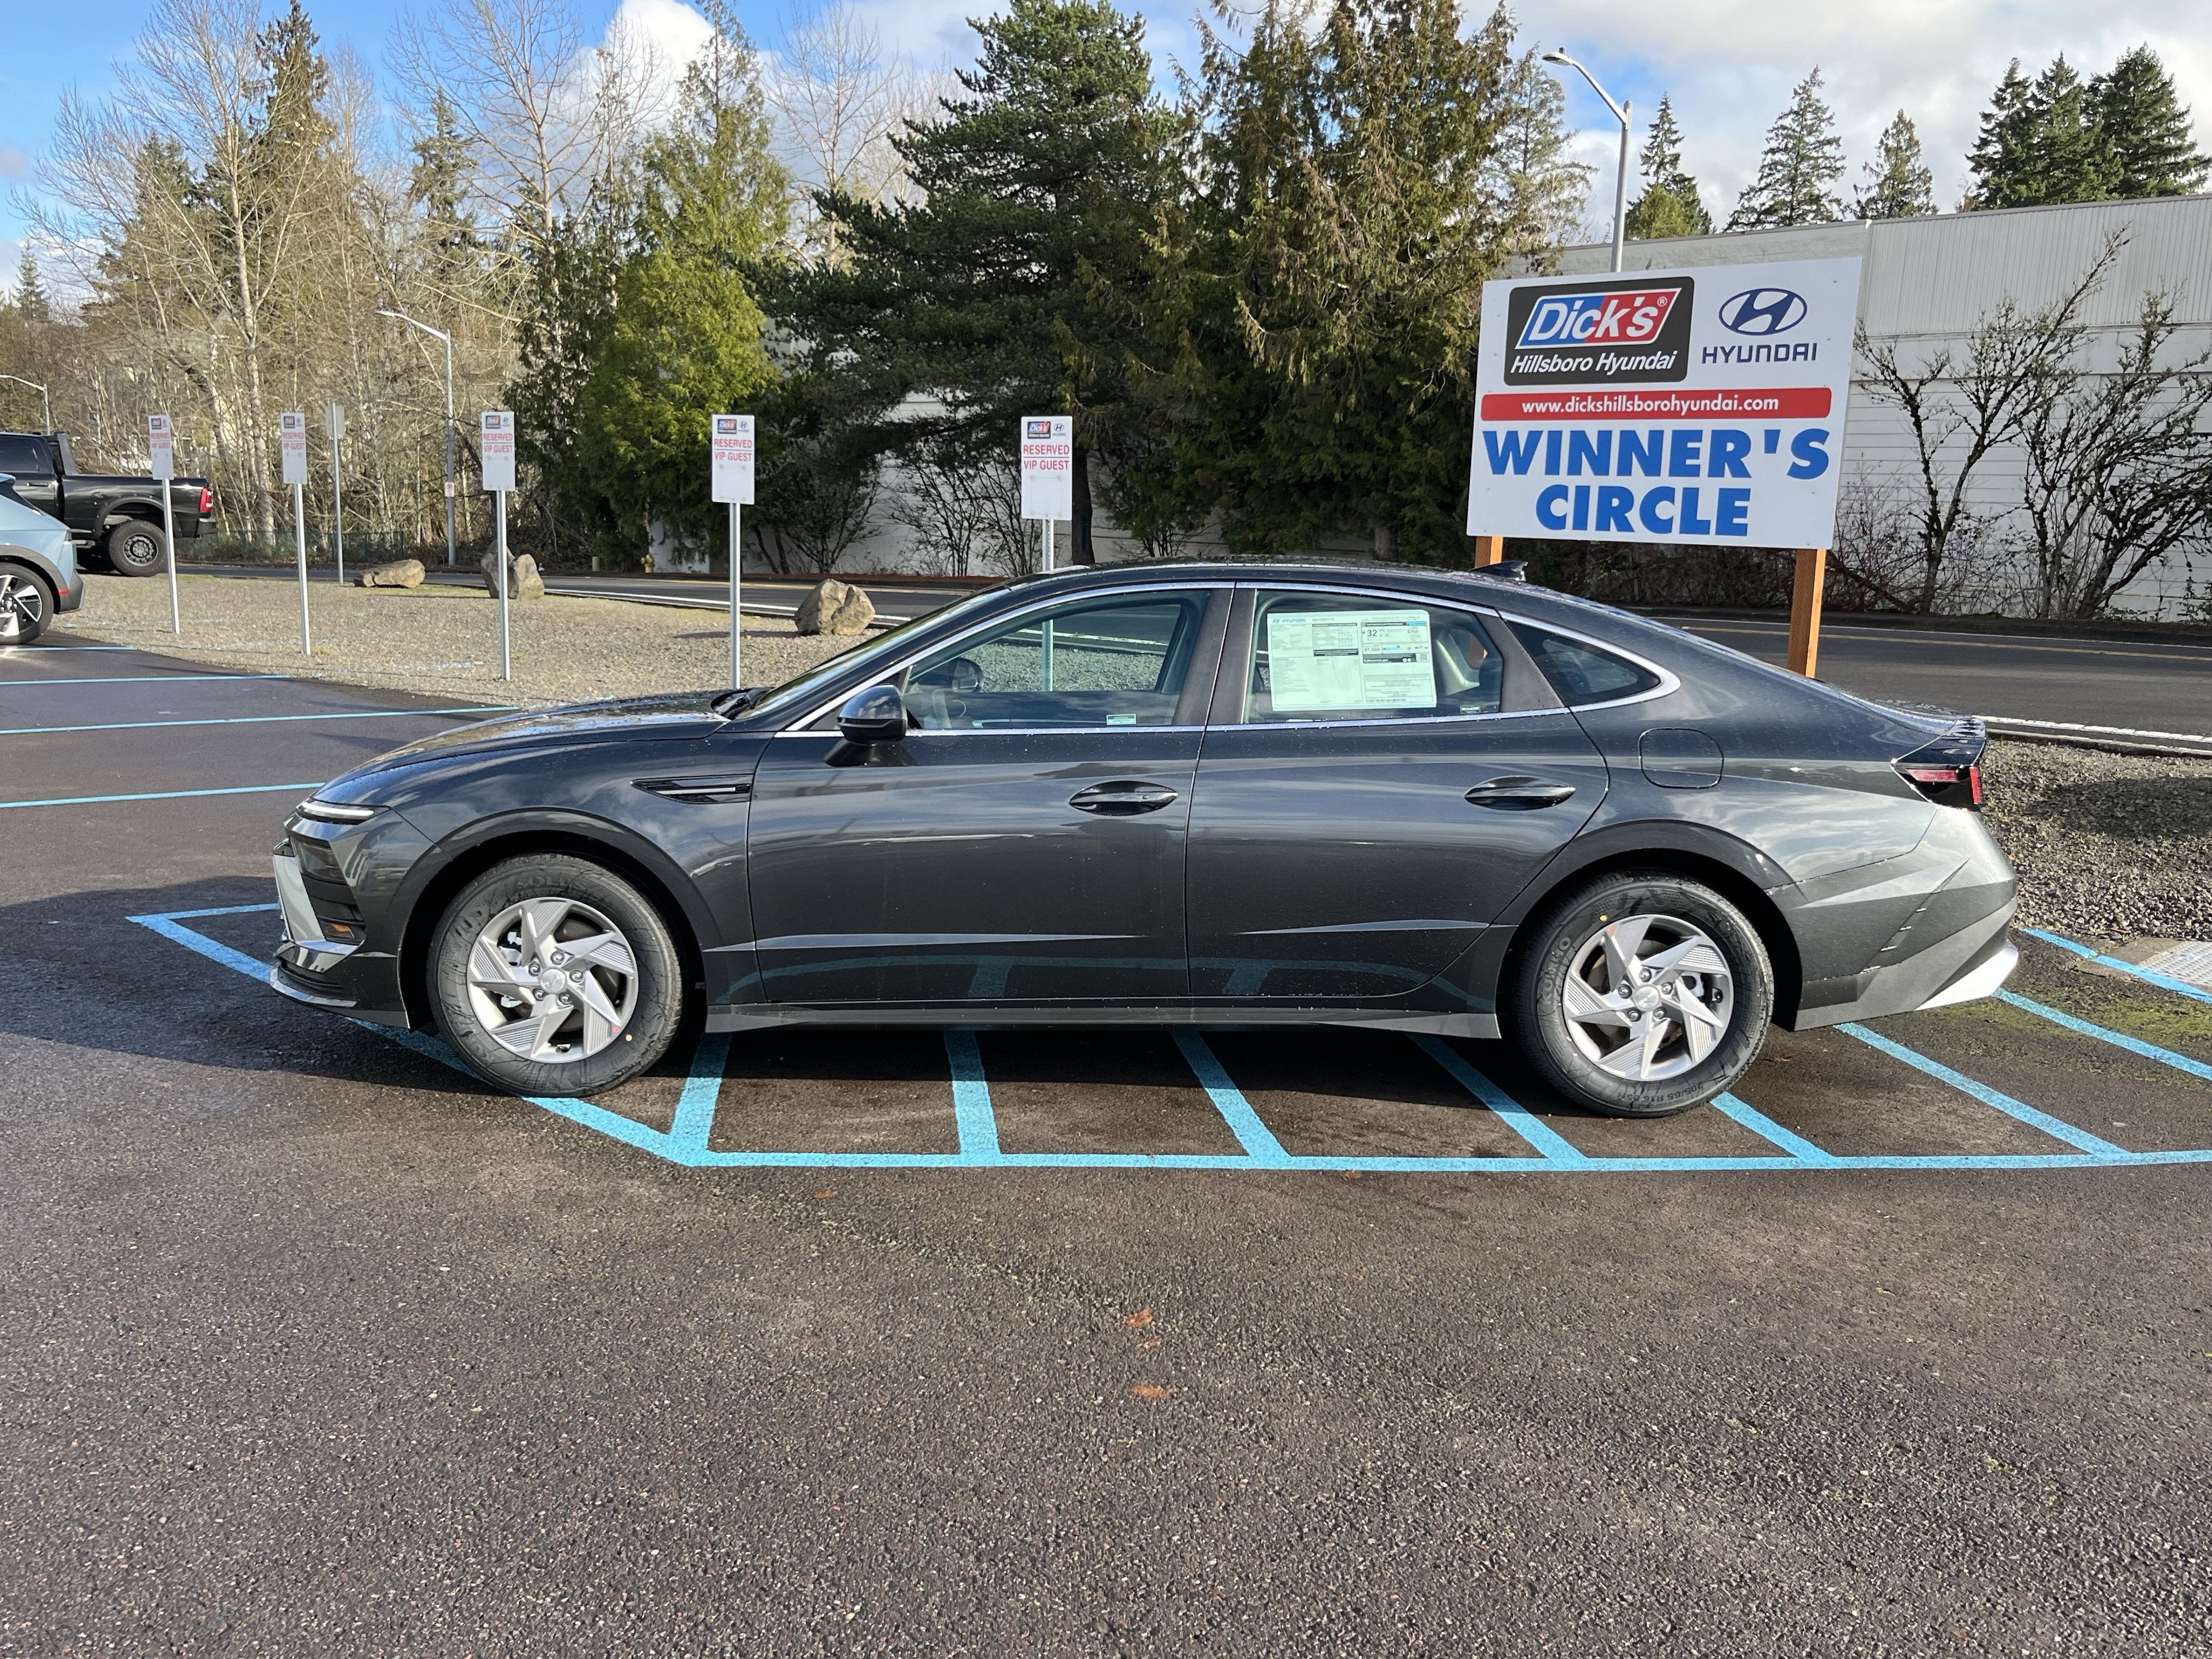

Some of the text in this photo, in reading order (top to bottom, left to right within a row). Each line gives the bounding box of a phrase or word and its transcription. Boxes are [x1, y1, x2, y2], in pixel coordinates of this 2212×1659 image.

[1701, 342, 1818, 364] HYUNDAI
[1510, 350, 1678, 376] Hillsboro Hyundai
[1522, 394, 1779, 416] www.dickshillsborohyundai.com
[494, 445, 512, 453] GUEST
[714, 438, 752, 449] RESERVED
[1023, 445, 1070, 455] RESERVED
[714, 452, 752, 462] VIP GUEST
[1483, 428, 1830, 480] WINNER'S
[1024, 460, 1069, 470] VIP GUEST
[1536, 484, 1752, 537] CIRCLE
